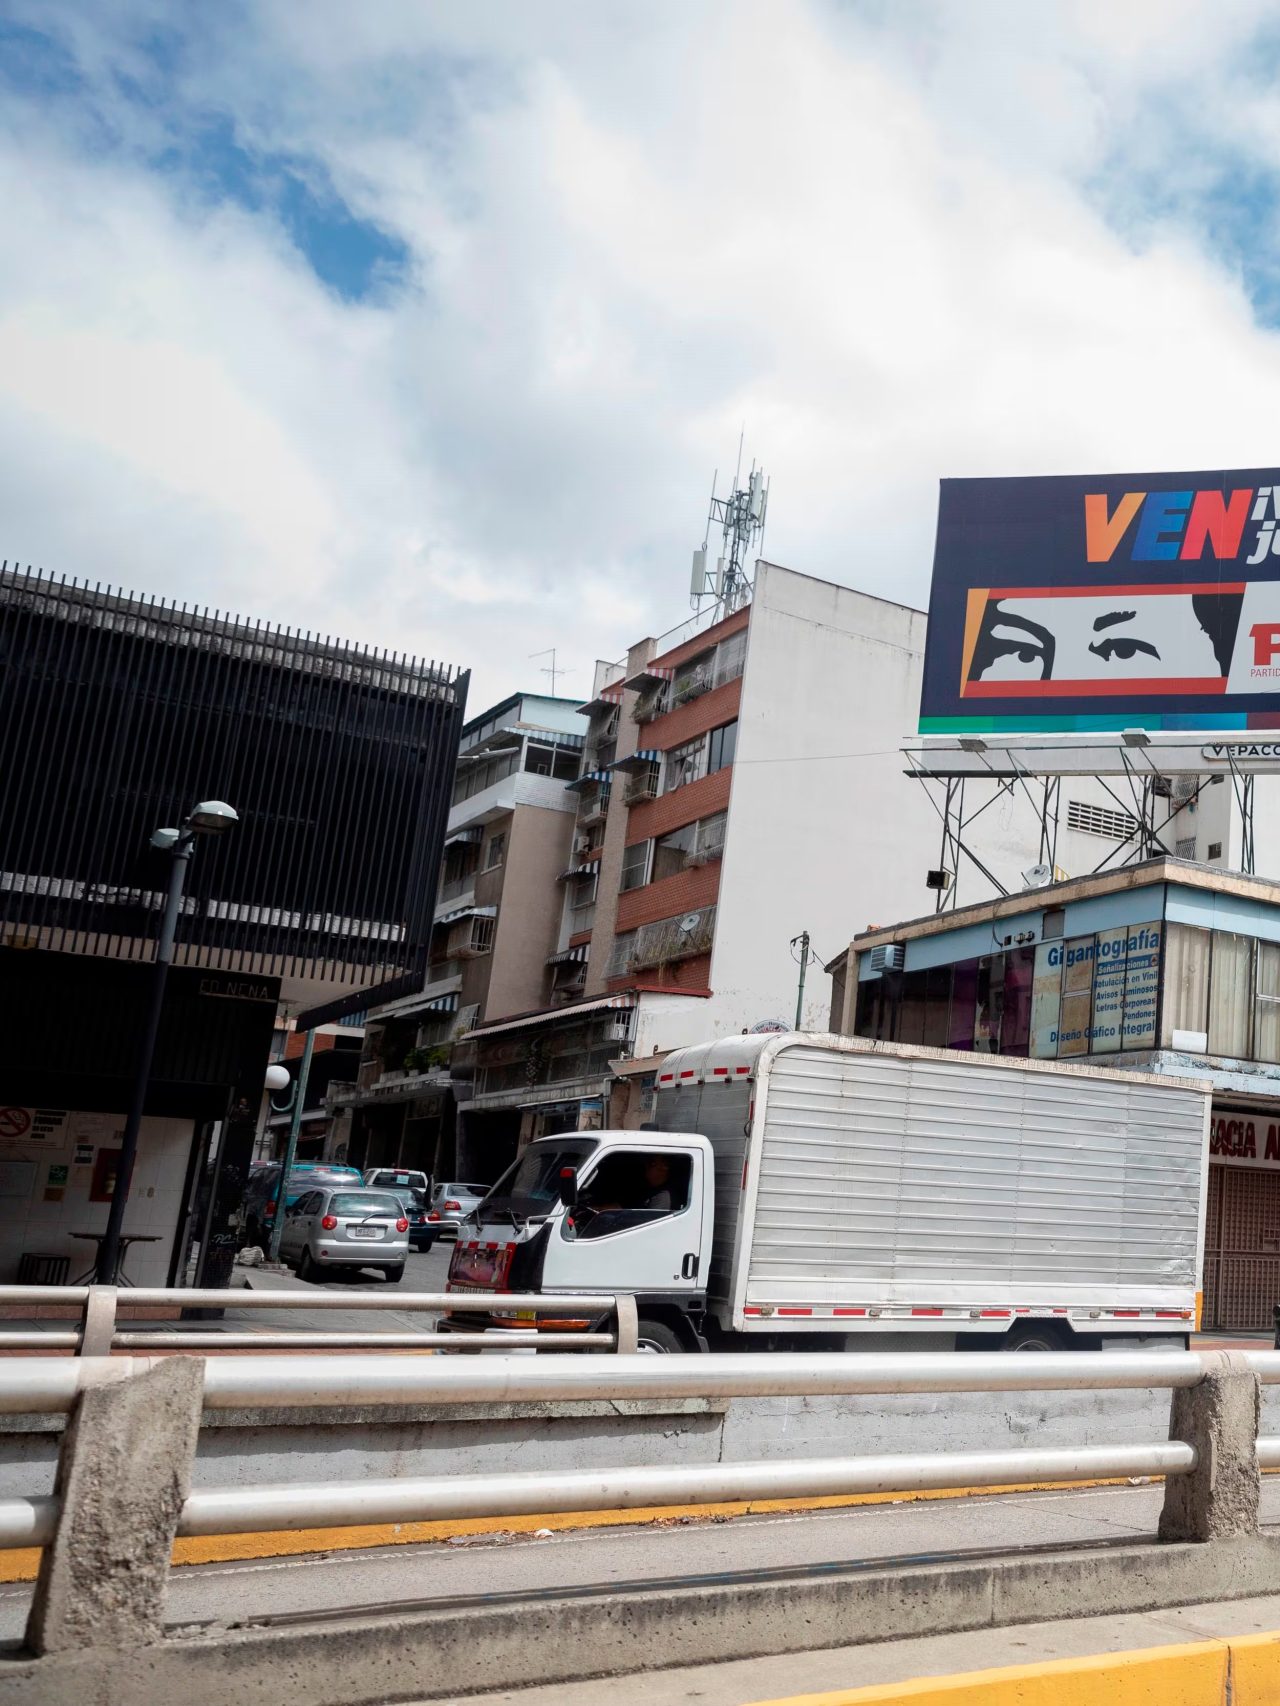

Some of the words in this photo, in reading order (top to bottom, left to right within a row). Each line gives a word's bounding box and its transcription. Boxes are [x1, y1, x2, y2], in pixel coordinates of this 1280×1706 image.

[1084, 489, 1254, 563] VEN
[1047, 928, 1159, 968] Gigantografía
[1131, 975, 1140, 983] en
[1142, 971, 1158, 980] Vinil
[1096, 990, 1118, 1000] Avisos
[1120, 985, 1158, 997] Luminosos
[1096, 1001, 1118, 1012] Letras
[1123, 1009, 1156, 1020] Pendones
[1118, 1019, 1155, 1036] Integral
